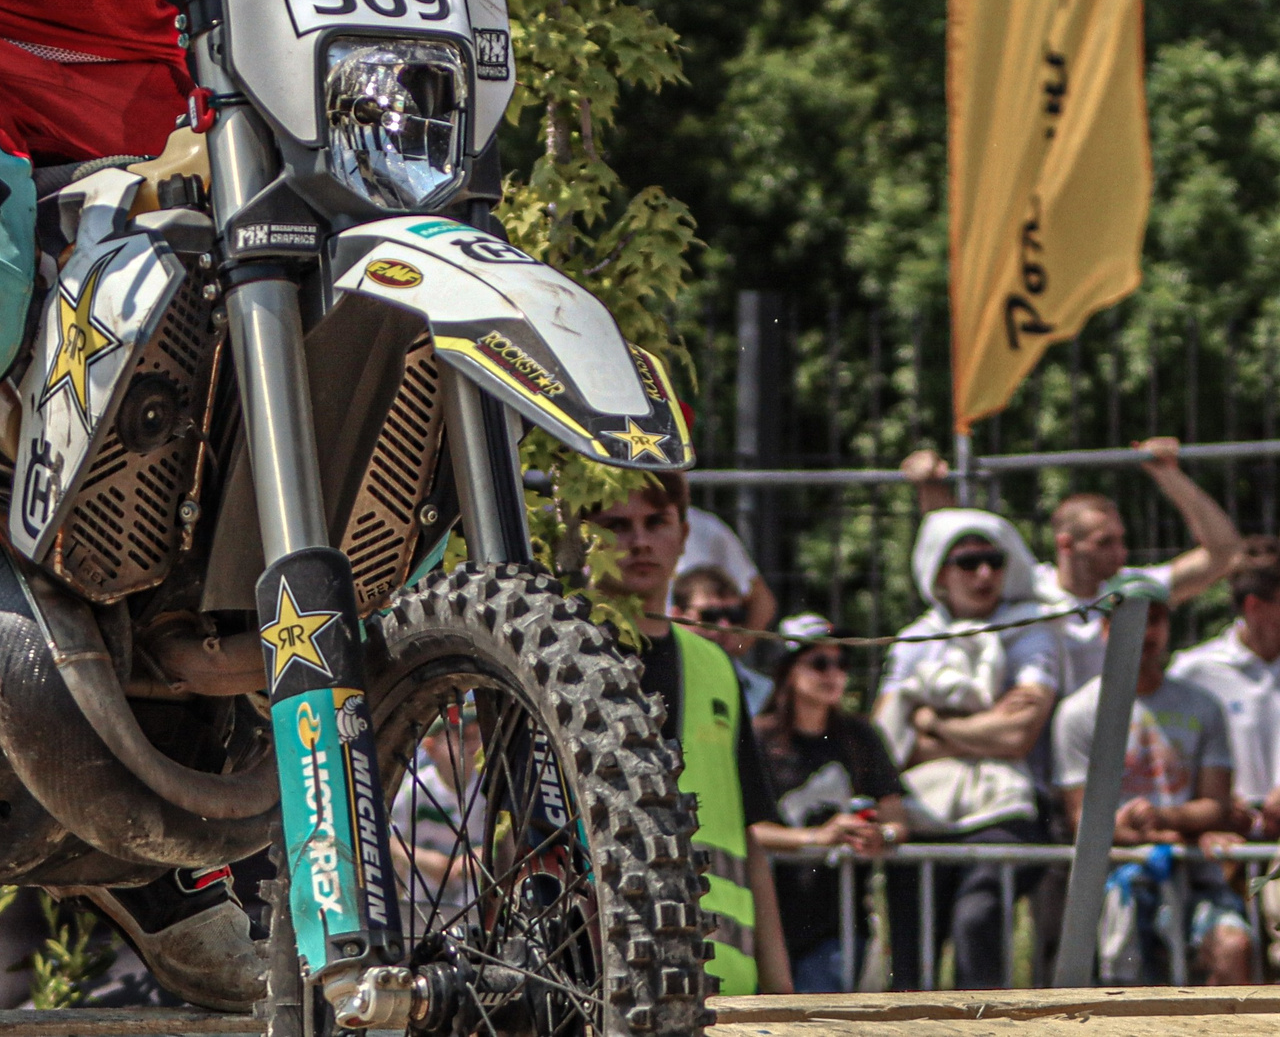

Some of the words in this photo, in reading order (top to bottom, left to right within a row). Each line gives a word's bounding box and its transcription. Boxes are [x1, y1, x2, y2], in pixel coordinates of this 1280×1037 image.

[270, 232, 316, 244] GRAPHICS
[367, 261, 422, 282] FMF
[299, 750, 343, 915] MOTOREX
[352, 749, 387, 925] MICHELIN
